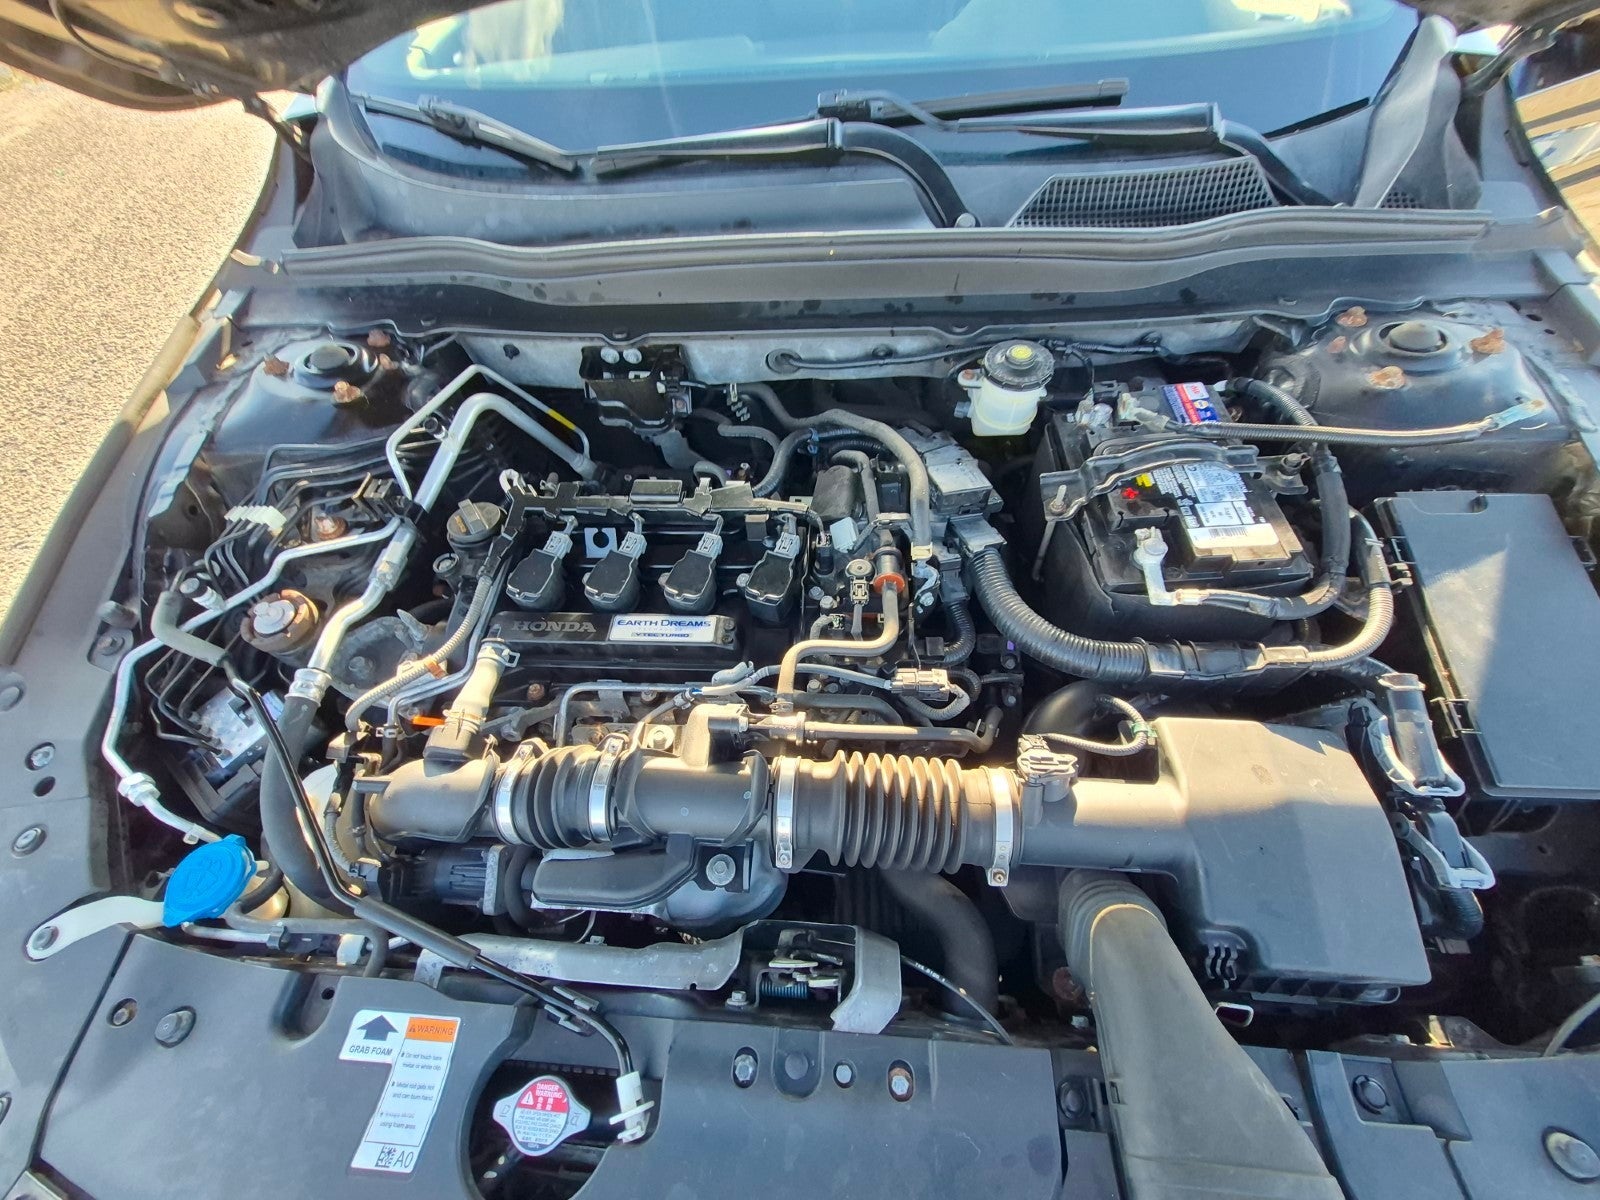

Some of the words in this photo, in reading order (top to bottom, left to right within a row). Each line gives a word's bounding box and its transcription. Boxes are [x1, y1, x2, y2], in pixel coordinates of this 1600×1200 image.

[511, 621, 597, 632] HONDA
[417, 1025, 454, 1036] WARNING
[349, 1045, 370, 1054] GRAB
[370, 1046, 393, 1056] FOAM
[536, 1083, 559, 1092] DANGER
